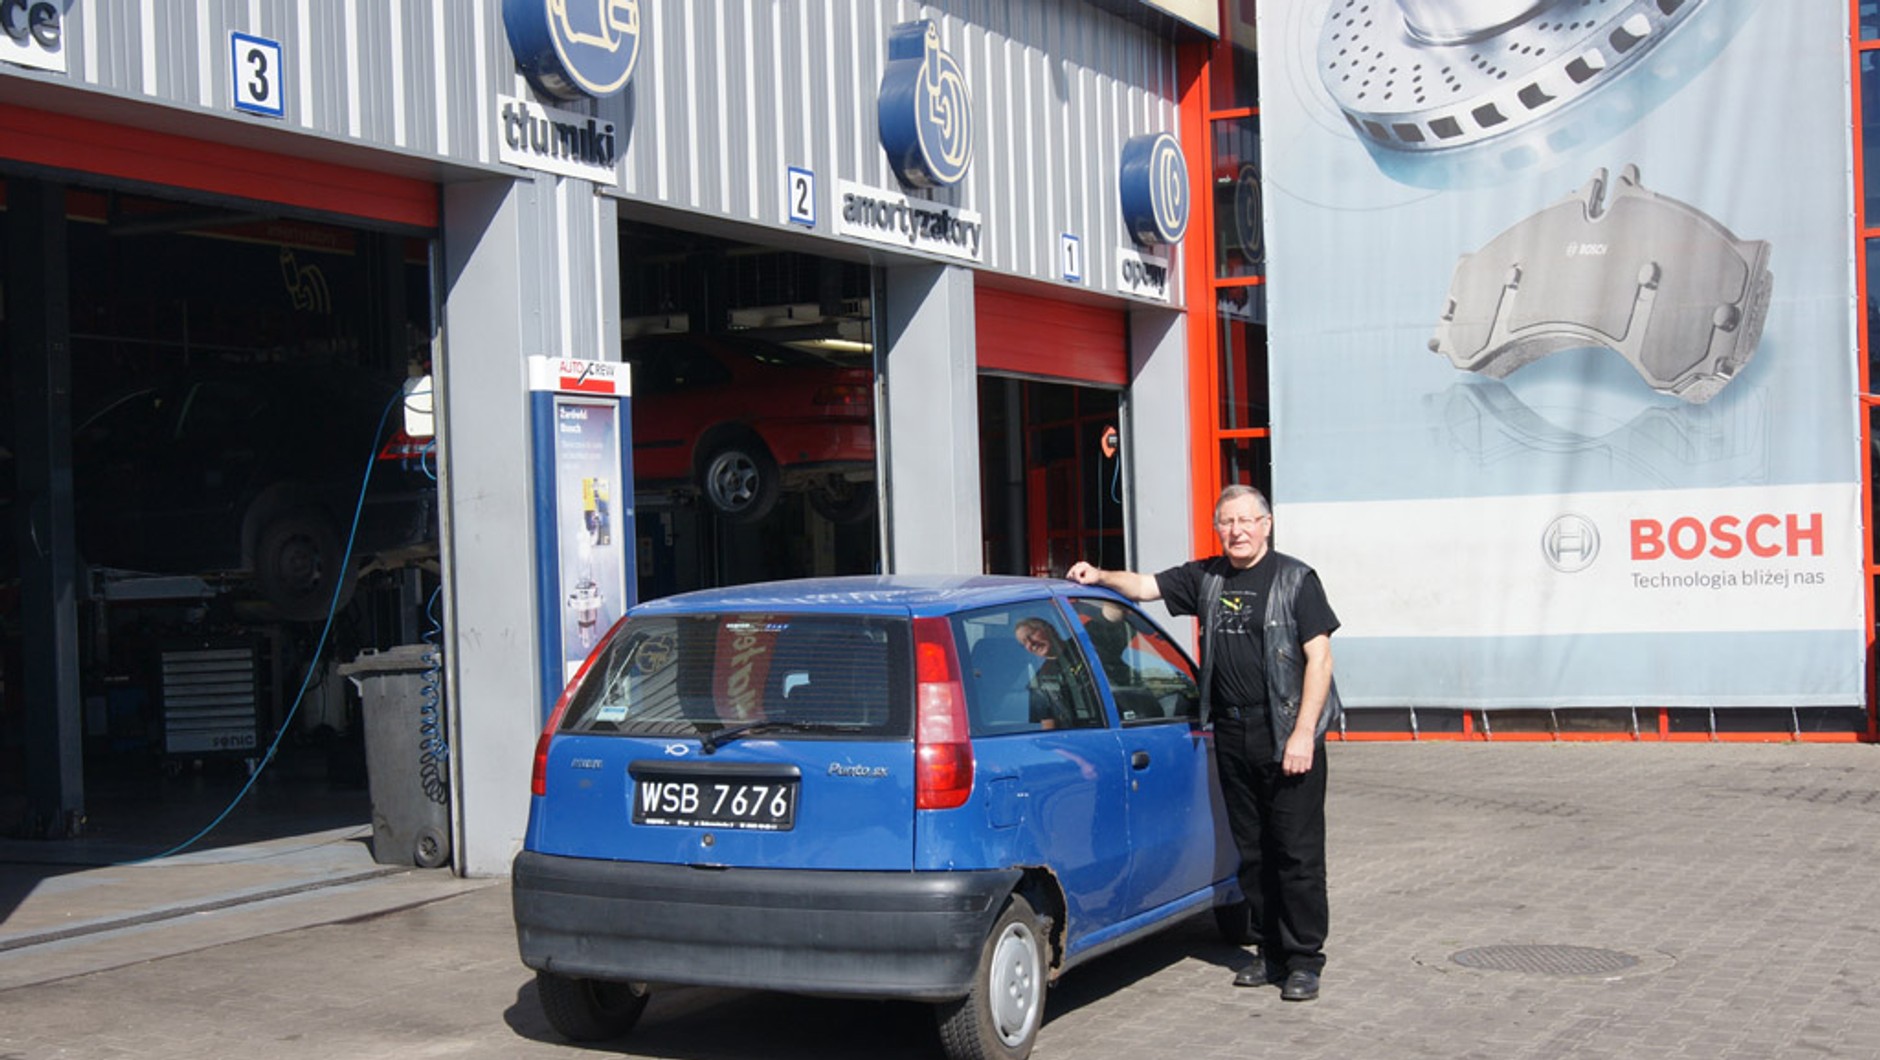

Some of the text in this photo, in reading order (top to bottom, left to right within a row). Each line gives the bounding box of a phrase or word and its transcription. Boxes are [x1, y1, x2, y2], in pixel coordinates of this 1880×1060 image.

[246, 48, 269, 102] 3
[502, 102, 615, 171] tłumiki
[796, 177, 808, 216] 2
[843, 192, 981, 258] amortyzatory
[1066, 242, 1074, 272] 1
[1579, 243, 1608, 256] BOSCH
[1630, 513, 1824, 561] BOSCH
[1631, 569, 1825, 589] Technologia bliżej nas
[827, 762, 871, 777] Punto
[642, 782, 788, 818] WSB 7676
